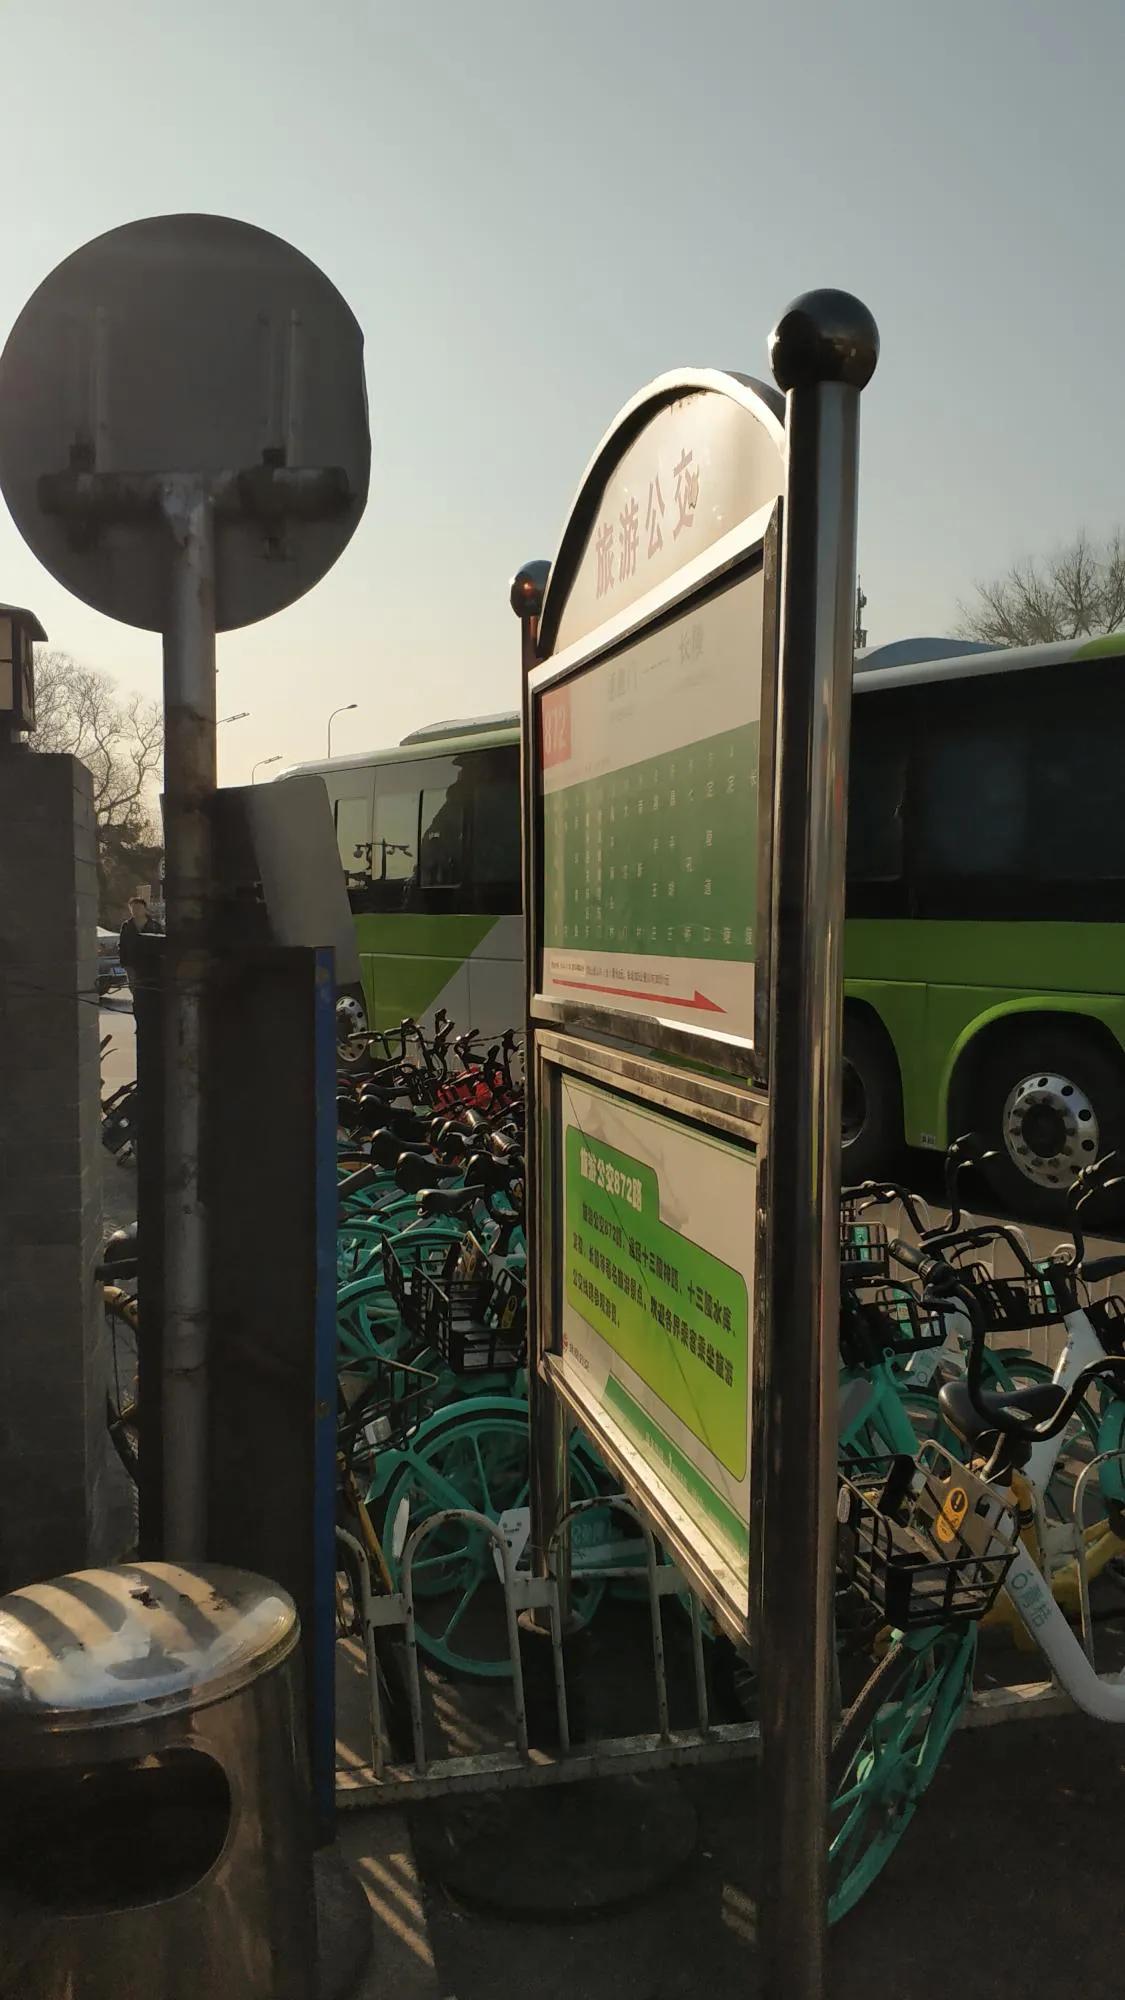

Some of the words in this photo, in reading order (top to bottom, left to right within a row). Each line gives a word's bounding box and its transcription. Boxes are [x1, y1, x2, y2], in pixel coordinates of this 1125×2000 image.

[595, 447, 700, 600] 旅游公交
[580, 1146, 643, 1213] 旅游公交872路
